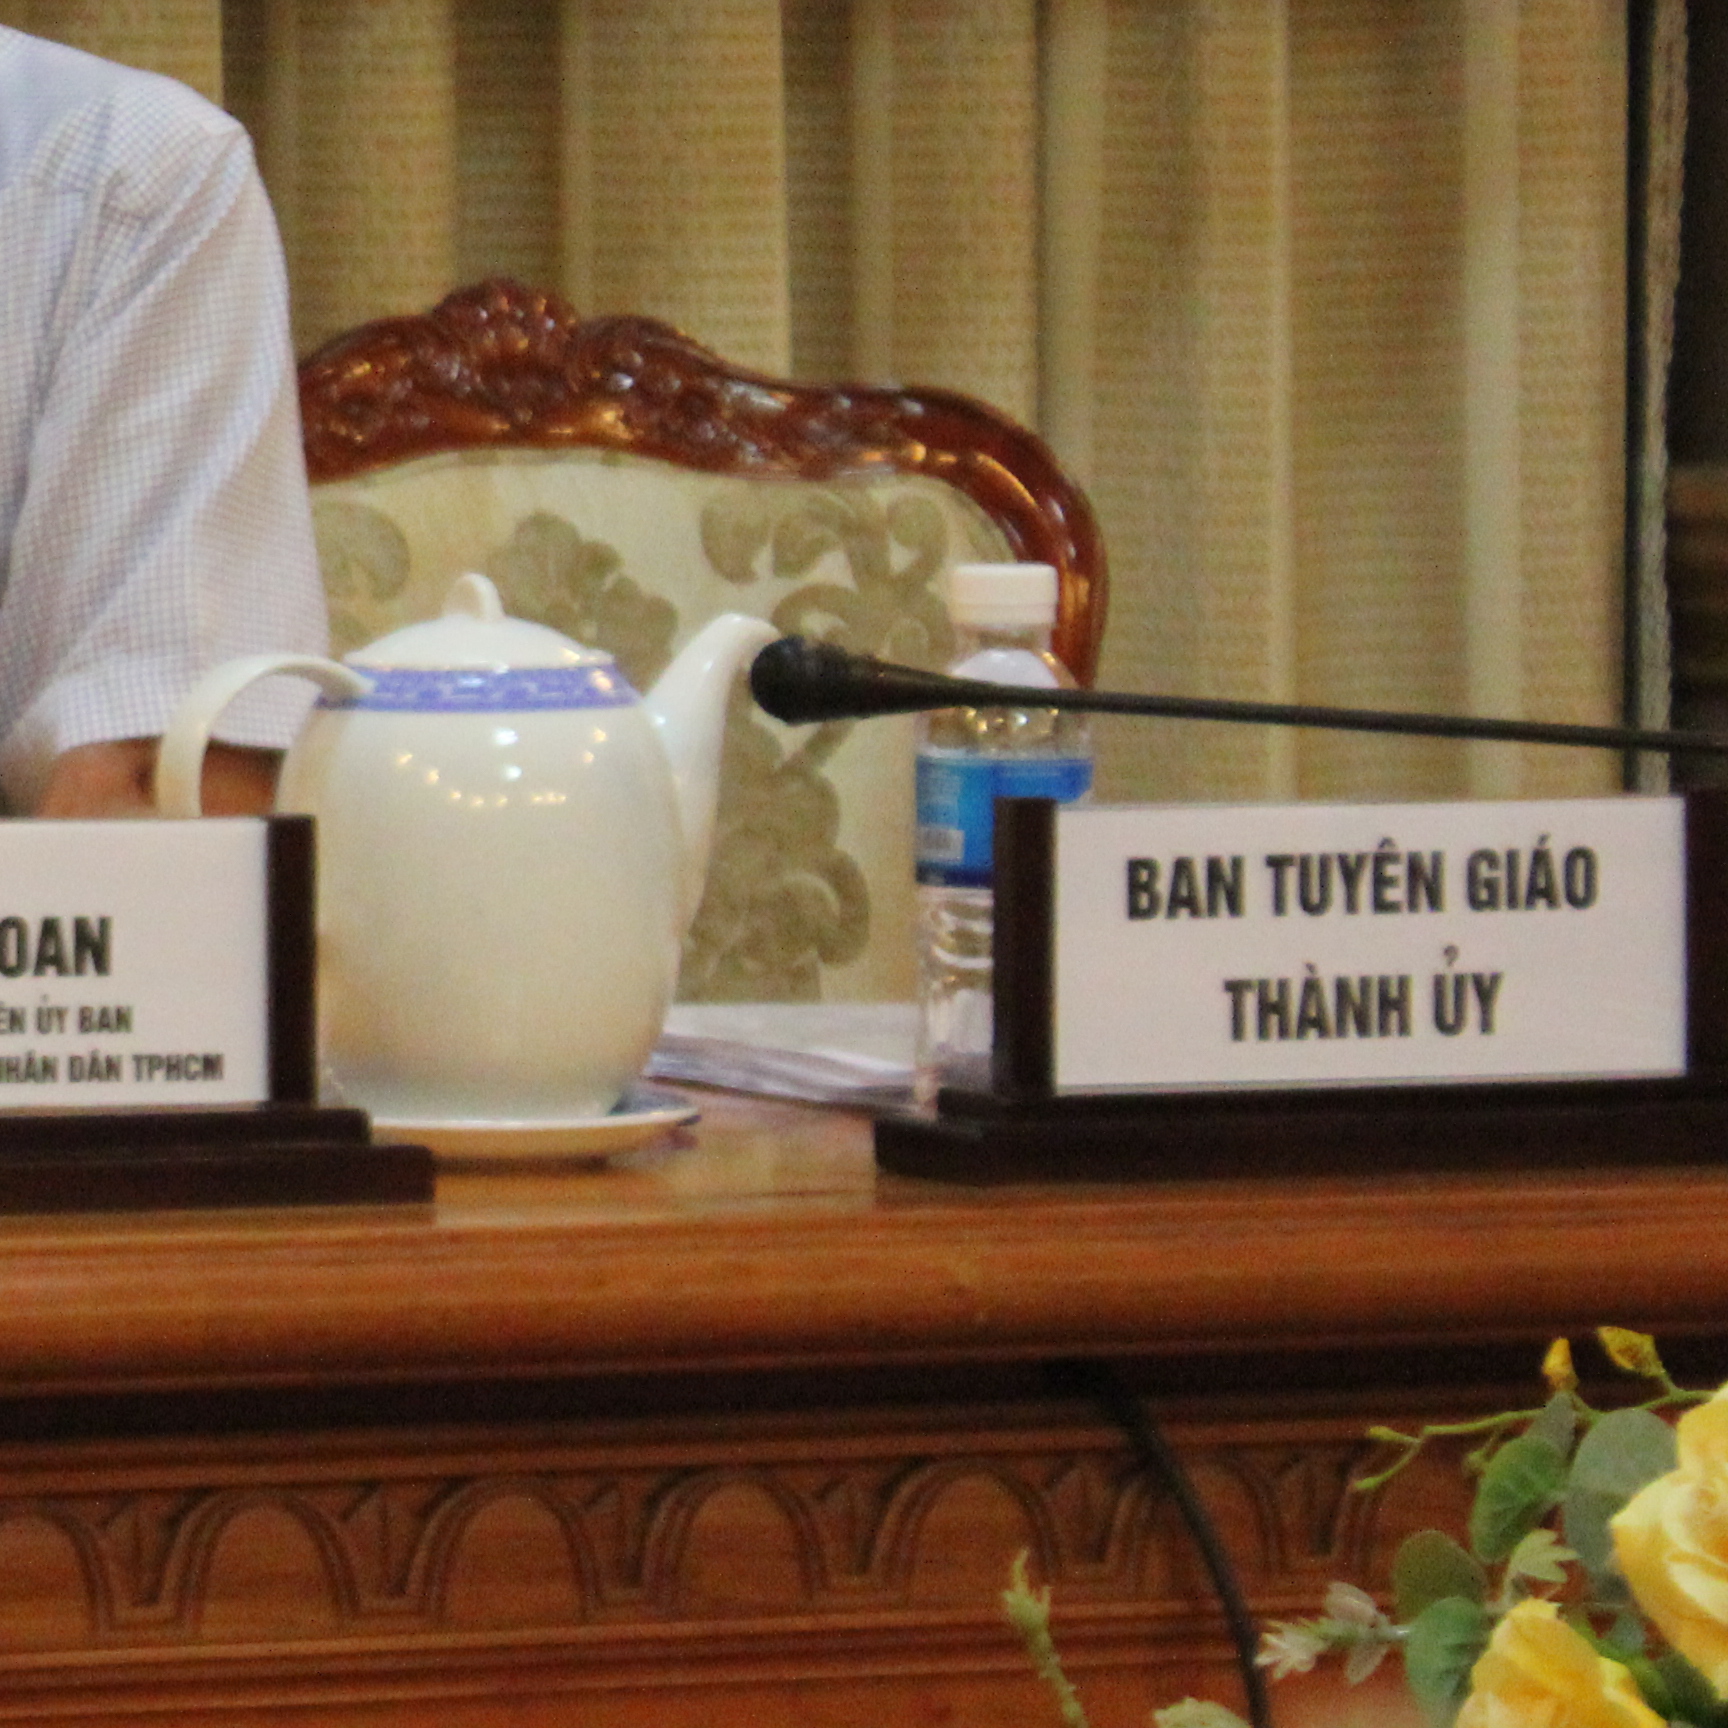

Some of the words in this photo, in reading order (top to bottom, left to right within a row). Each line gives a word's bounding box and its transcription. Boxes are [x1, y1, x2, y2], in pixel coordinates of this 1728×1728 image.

[1127, 855, 1244, 920] BAN
[1265, 837, 1445, 917] TUYÊN
[1466, 833, 1599, 910] GIÁO
[35, 994, 70, 1035] ỦY
[77, 1005, 134, 1034] BAN
[1223, 962, 1413, 1041] THÀNH
[1433, 945, 1504, 1035] ỦY
[68, 1049, 123, 1083] DÂN
[132, 1053, 225, 1082] TPHCM
